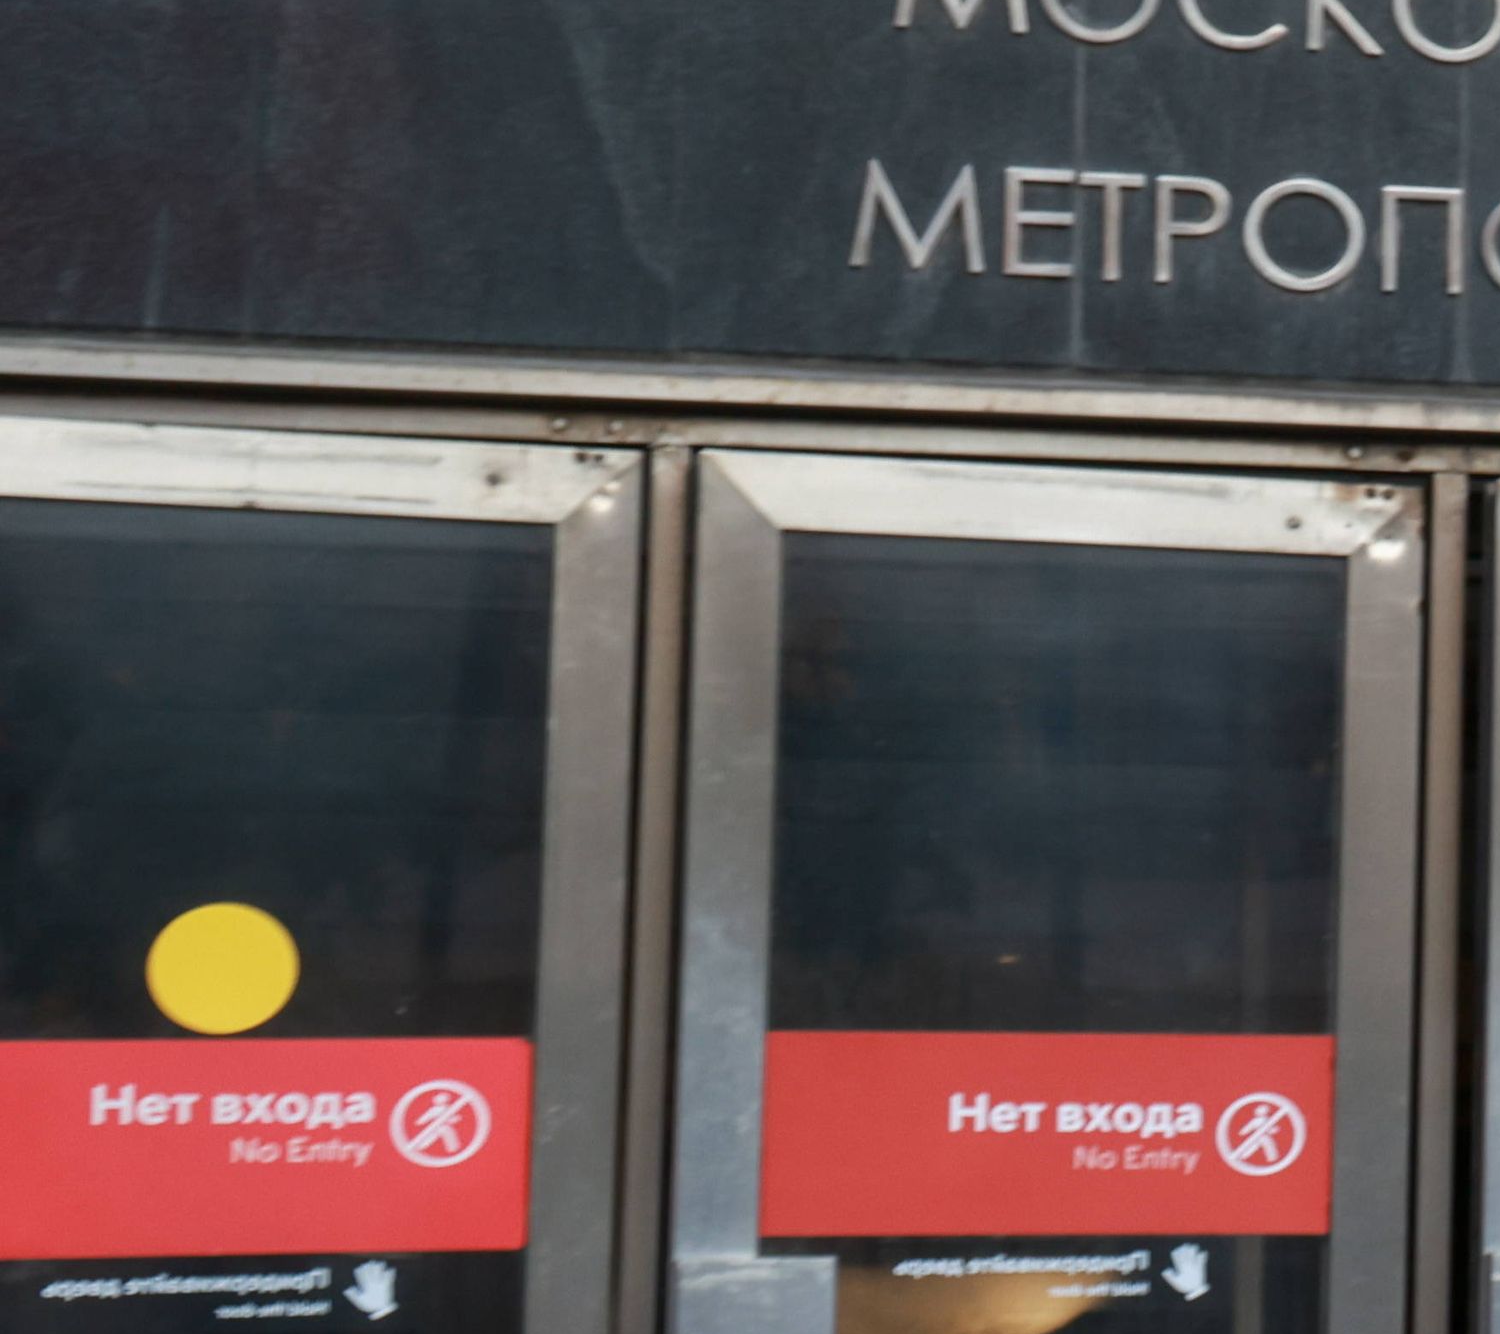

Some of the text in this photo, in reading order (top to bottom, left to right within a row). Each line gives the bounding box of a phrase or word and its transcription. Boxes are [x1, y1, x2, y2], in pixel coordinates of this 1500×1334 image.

[89, 1082, 377, 1131] Нет входа
[947, 1091, 1204, 1140] Нет входа
[229, 1135, 375, 1168] No Entry
[1072, 1143, 1201, 1175] No Entry
